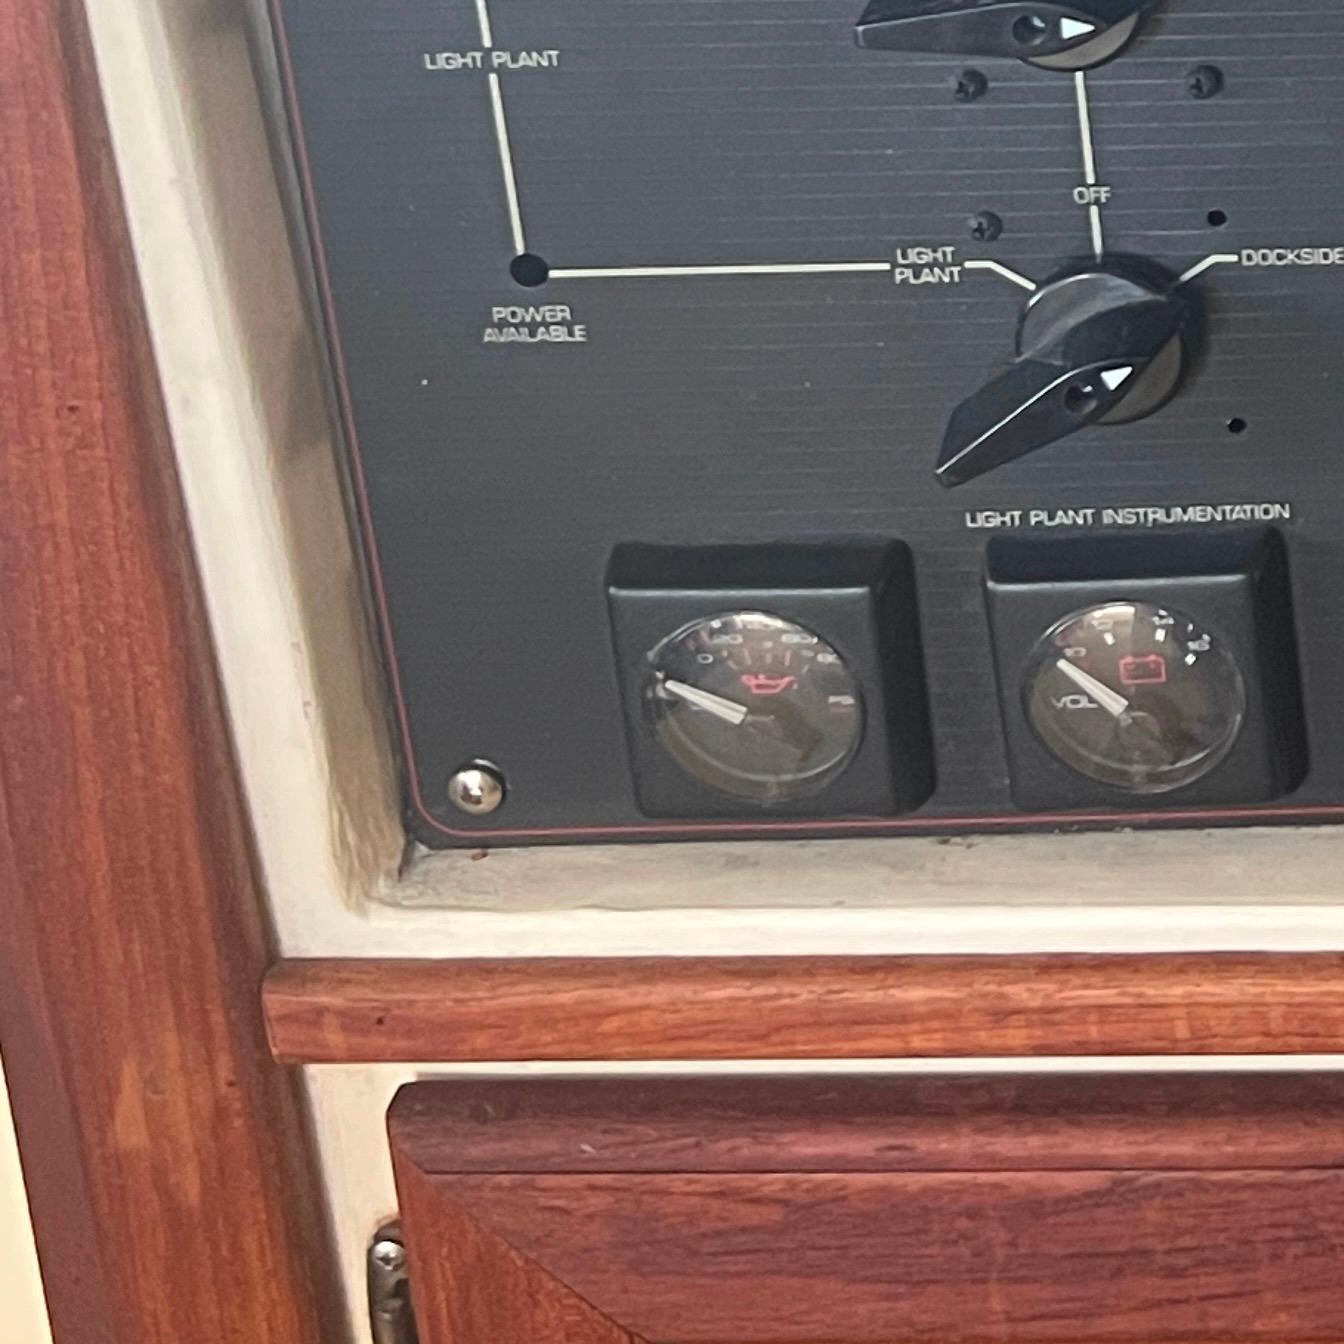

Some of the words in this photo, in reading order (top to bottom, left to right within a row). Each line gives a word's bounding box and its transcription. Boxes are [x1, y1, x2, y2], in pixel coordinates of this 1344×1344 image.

[424, 51, 484, 70] LIGHT
[492, 50, 560, 69] PLANT
[1074, 186, 1111, 204] OFF
[896, 247, 954, 265] LIGHT
[895, 266, 961, 285] PLANT
[493, 305, 571, 323] POWER
[483, 323, 586, 343] AVAILABLE
[965, 510, 1021, 529] LIGHT
[1030, 508, 1095, 527] PLANT
[1102, 502, 1290, 525] INSTRUMENTATION
